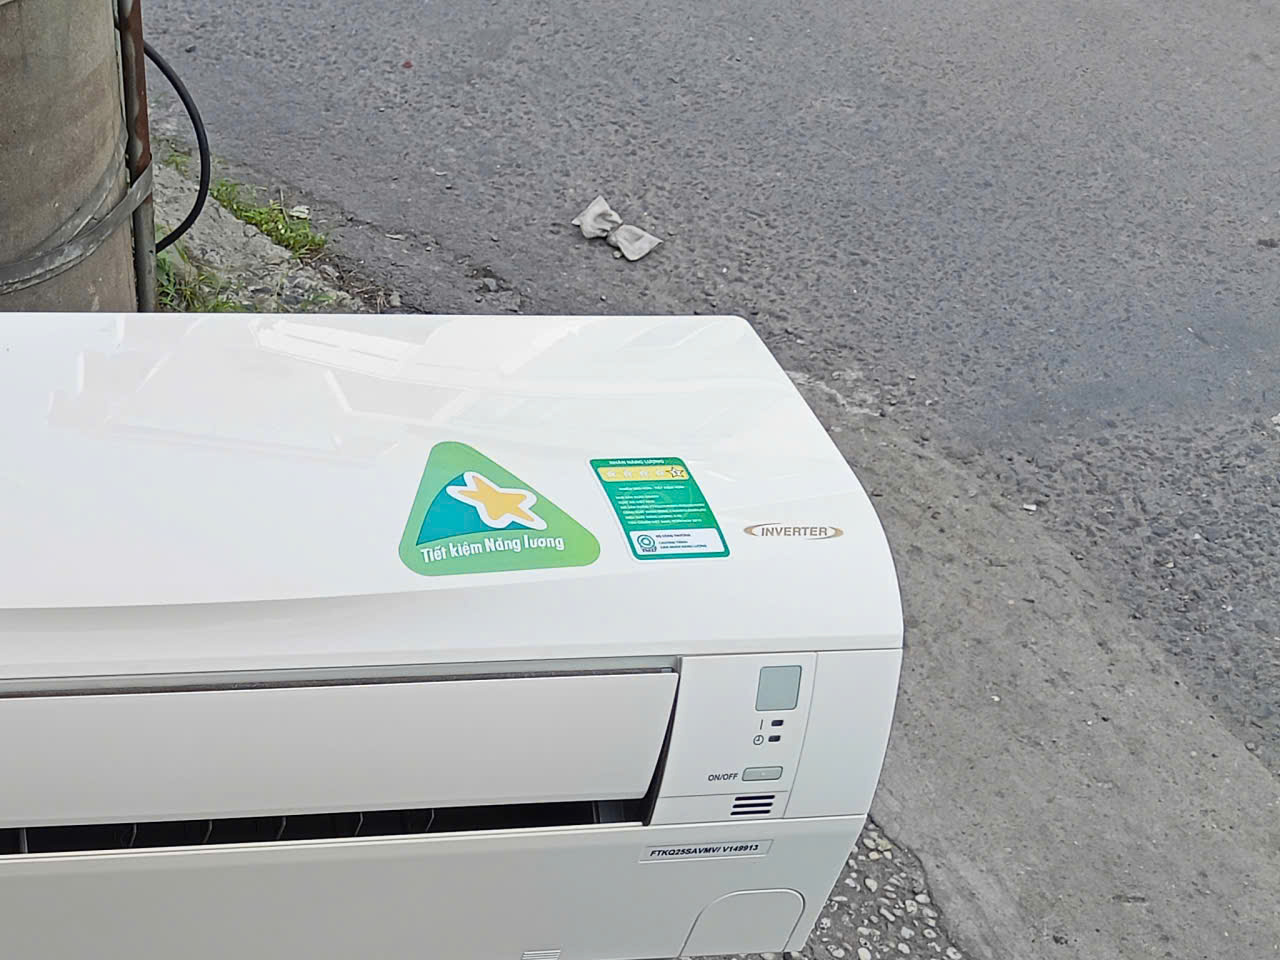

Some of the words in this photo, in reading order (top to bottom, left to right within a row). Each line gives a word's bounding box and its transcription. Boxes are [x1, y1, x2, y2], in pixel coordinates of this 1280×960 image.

[761, 526, 827, 537] INVERTER
[420, 546, 447, 563] Tiết
[449, 542, 483, 557] kiệm
[485, 537, 521, 552] Năng
[708, 773, 738, 781] ON/OFF
